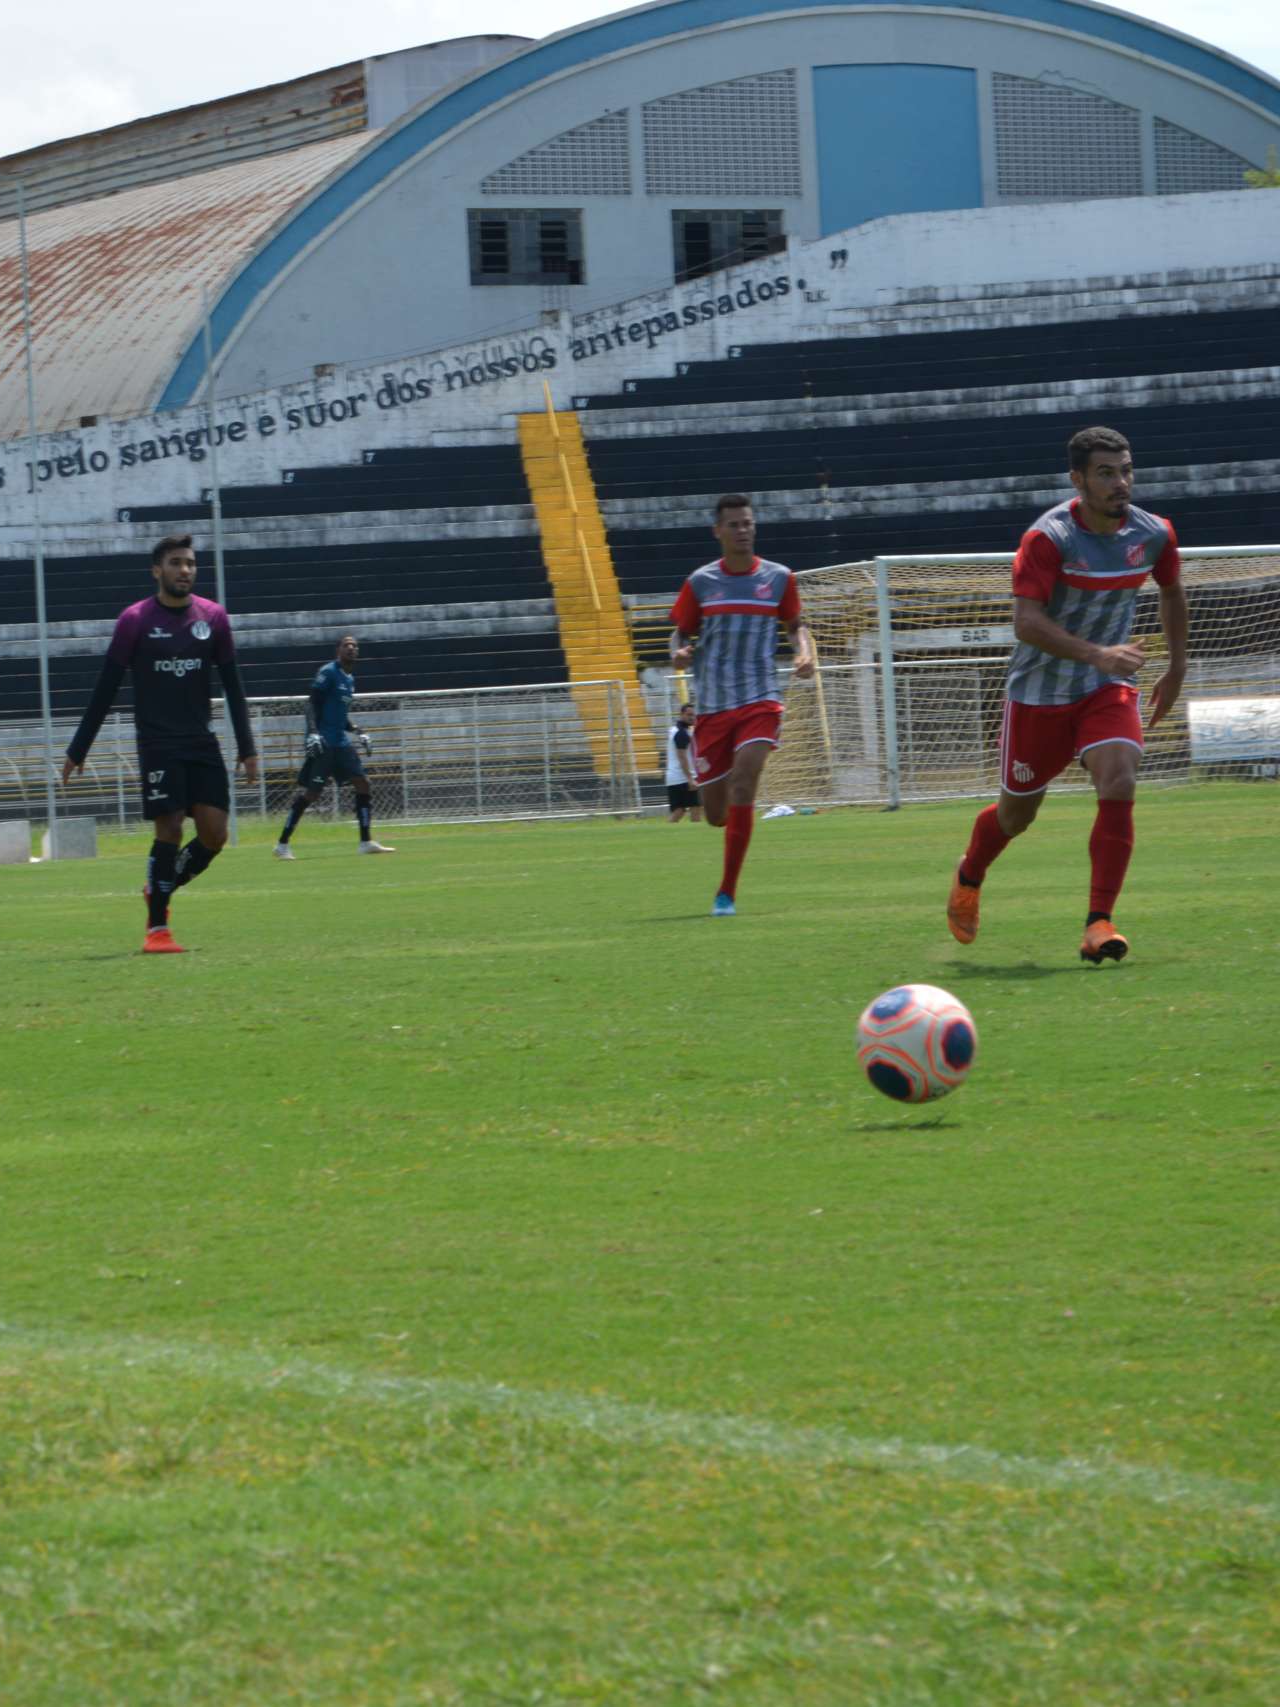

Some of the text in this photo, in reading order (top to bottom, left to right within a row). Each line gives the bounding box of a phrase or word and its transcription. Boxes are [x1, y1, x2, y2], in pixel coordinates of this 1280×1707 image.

[26, 439, 109, 493] pelo
[119, 420, 247, 468] sangue
[258, 413, 277, 437] e
[286, 393, 368, 432] suor
[376, 373, 432, 411] dos
[443, 346, 557, 392] nossos
[961, 629, 991, 642] BAR
[147, 770, 166, 784] 07
